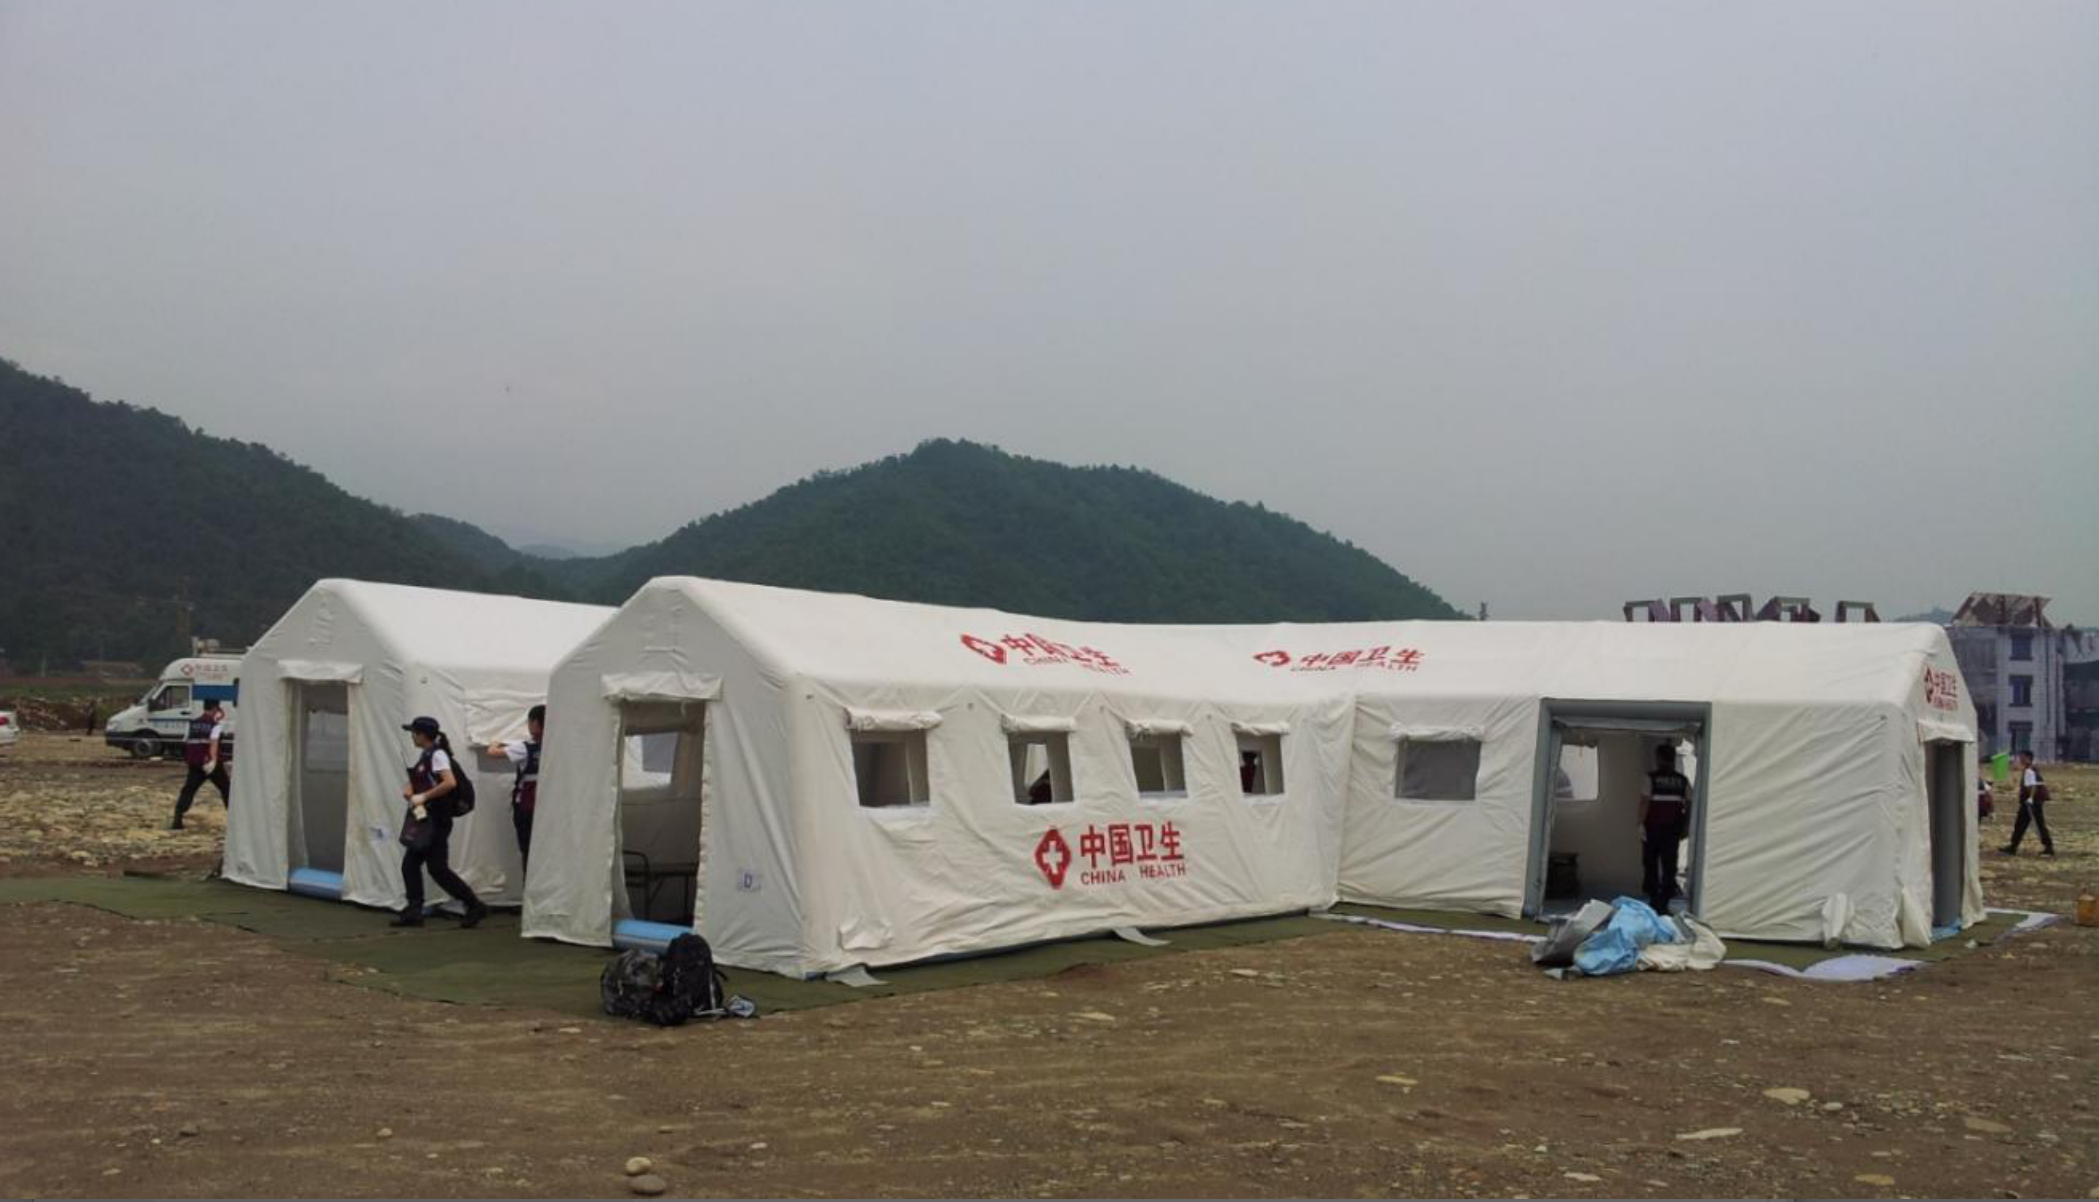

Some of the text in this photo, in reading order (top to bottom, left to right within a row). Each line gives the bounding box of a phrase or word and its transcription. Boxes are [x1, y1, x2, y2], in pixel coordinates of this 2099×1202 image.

[1079, 820, 1185, 870] 中国卫生
[1080, 863, 1187, 886] CHINA HEALTH
